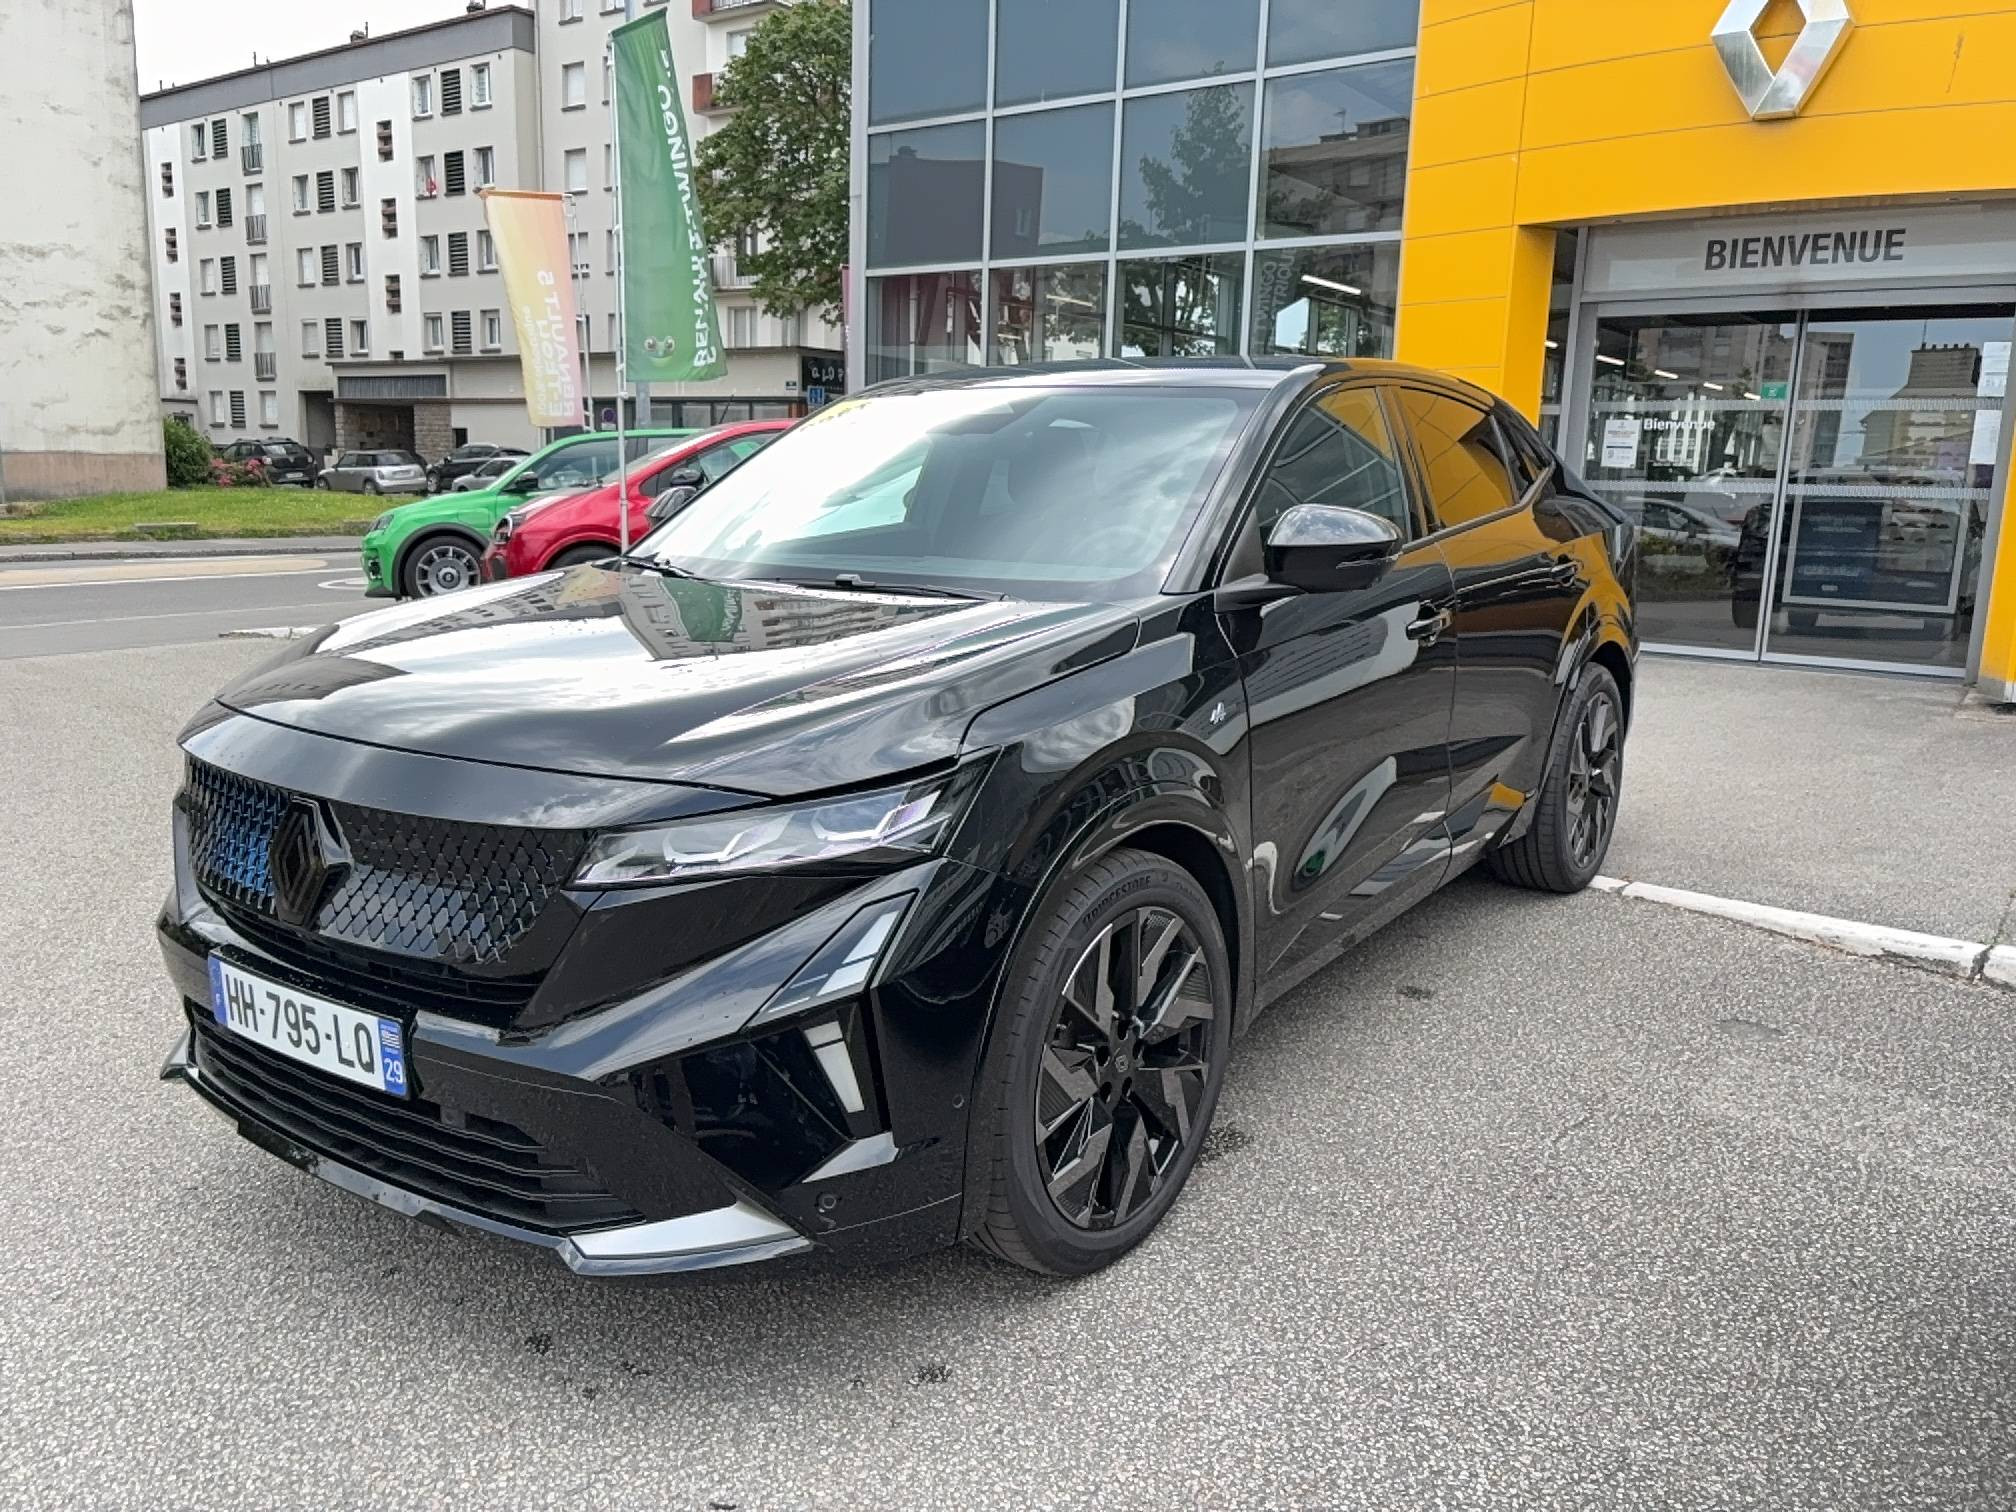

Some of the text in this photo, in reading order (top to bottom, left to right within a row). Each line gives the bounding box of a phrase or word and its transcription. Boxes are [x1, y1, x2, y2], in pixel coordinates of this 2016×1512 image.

[1704, 228, 1906, 271] BIENVENUE
[225, 973, 375, 1075] HH-795-LQ
[383, 1058, 404, 1085] 29
